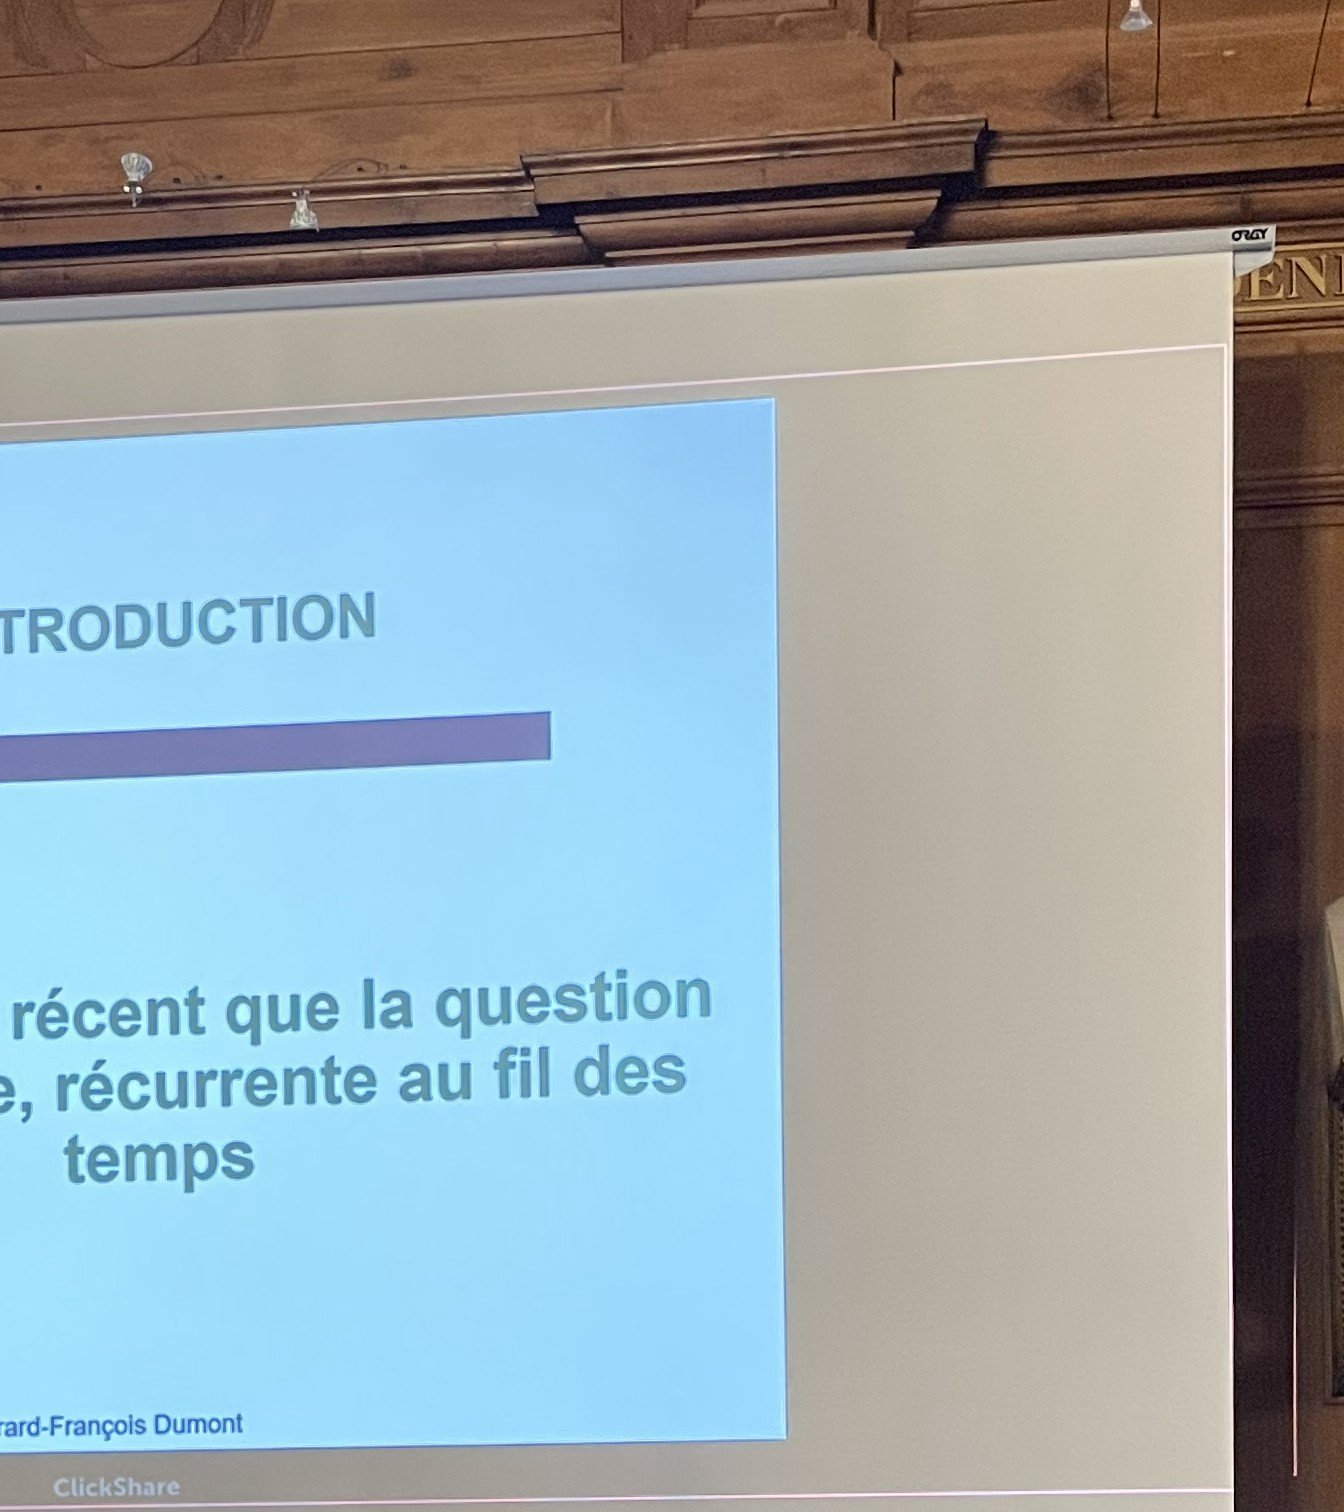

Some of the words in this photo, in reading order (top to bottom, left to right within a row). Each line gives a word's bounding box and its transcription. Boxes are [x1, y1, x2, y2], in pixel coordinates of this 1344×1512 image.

[13, 986, 208, 1042] récent
[226, 992, 341, 1049] que
[364, 979, 415, 1032] la
[436, 968, 712, 1041] question
[58, 1055, 379, 1113] récurrente
[399, 1062, 473, 1106] au
[493, 1046, 551, 1101] fil
[574, 1043, 689, 1099] des
[63, 1134, 257, 1195] temps
[154, 1413, 244, 1436] Dumont
[53, 1476, 181, 1498] ClickShare
